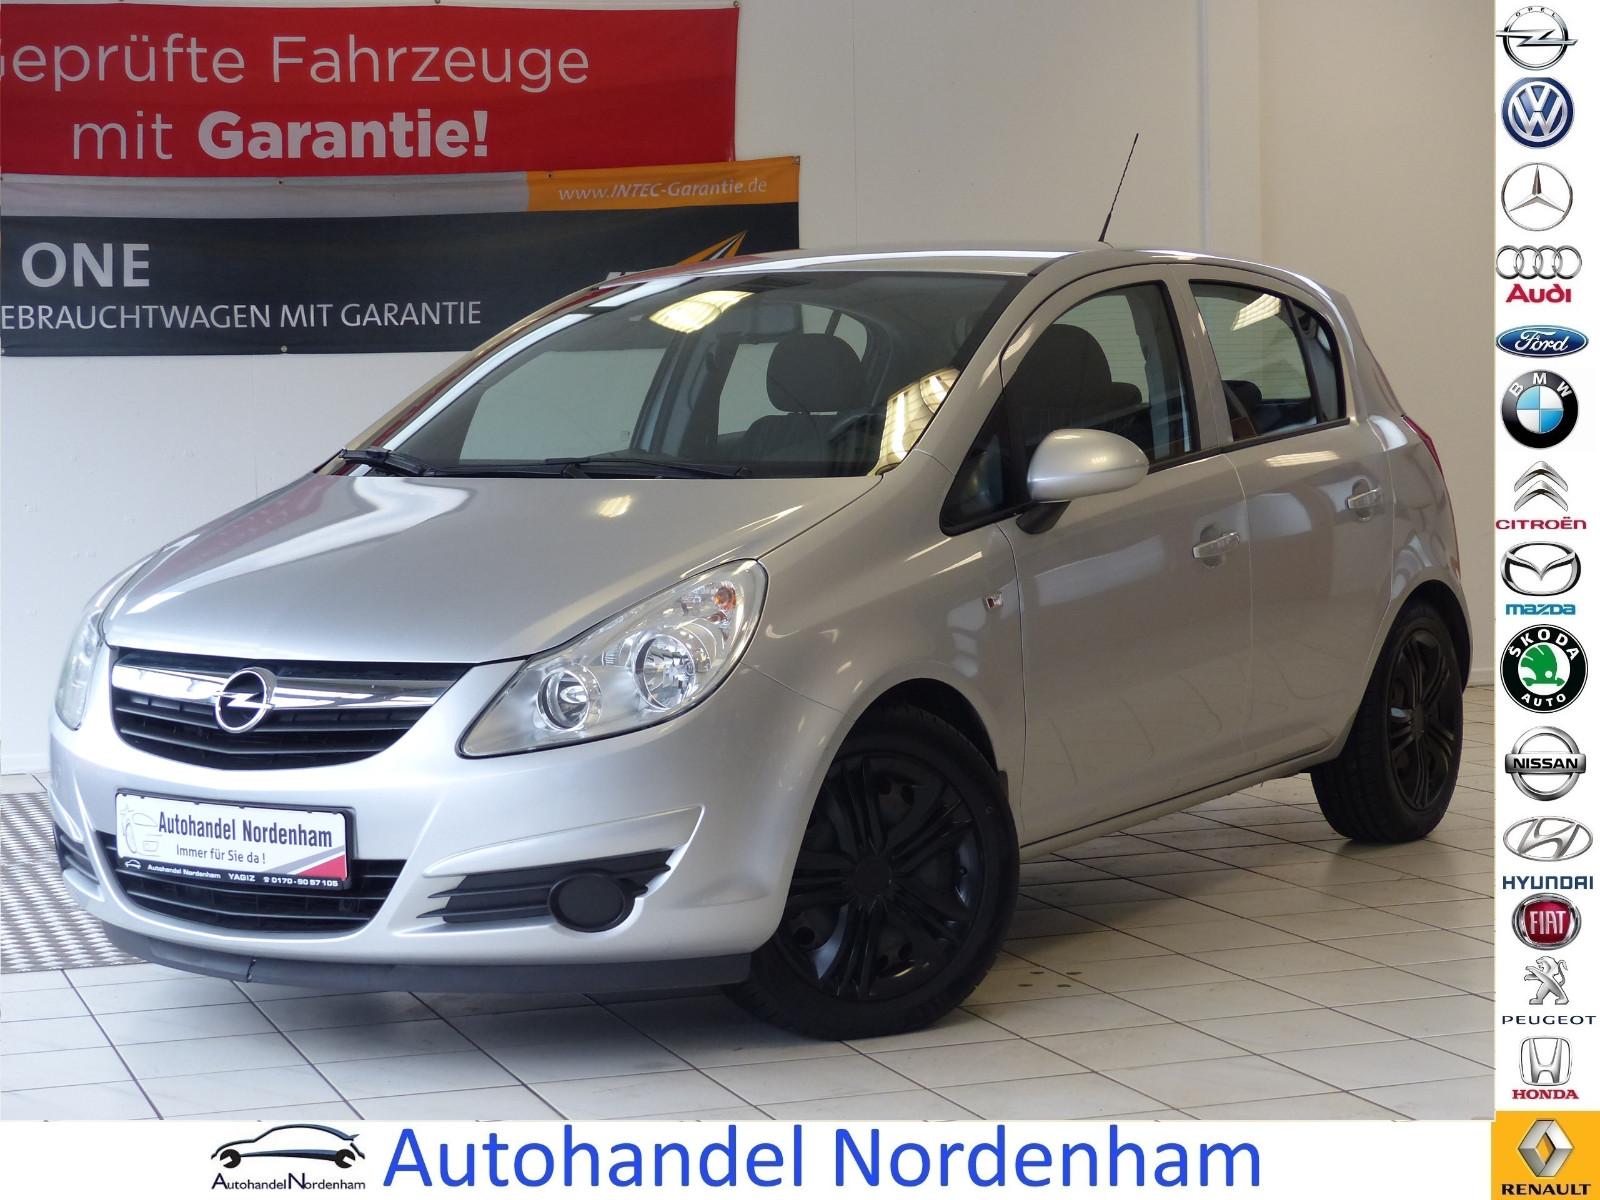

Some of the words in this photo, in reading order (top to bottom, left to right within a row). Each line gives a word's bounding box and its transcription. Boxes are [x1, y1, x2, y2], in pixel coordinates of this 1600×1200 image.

[0, 33, 245, 92] eprüfte
[272, 34, 589, 93] Fahrzeuge
[73, 110, 173, 160] mit
[198, 109, 488, 160] Garantie!
[558, 177, 768, 201] www.INTEC-Garantie.de
[21, 242, 150, 288] ONE
[280, 303, 333, 328] MIT
[340, 300, 481, 327] GARANTIE
[158, 811, 235, 840] Autohandel
[243, 819, 332, 848] Nordenham
[176, 844, 207, 859] Immer
[210, 847, 225, 861] für
[228, 849, 244, 863] Sie
[246, 851, 259, 864] da
[147, 864, 181, 875] Autohandel
[183, 868, 221, 879] Nordenham
